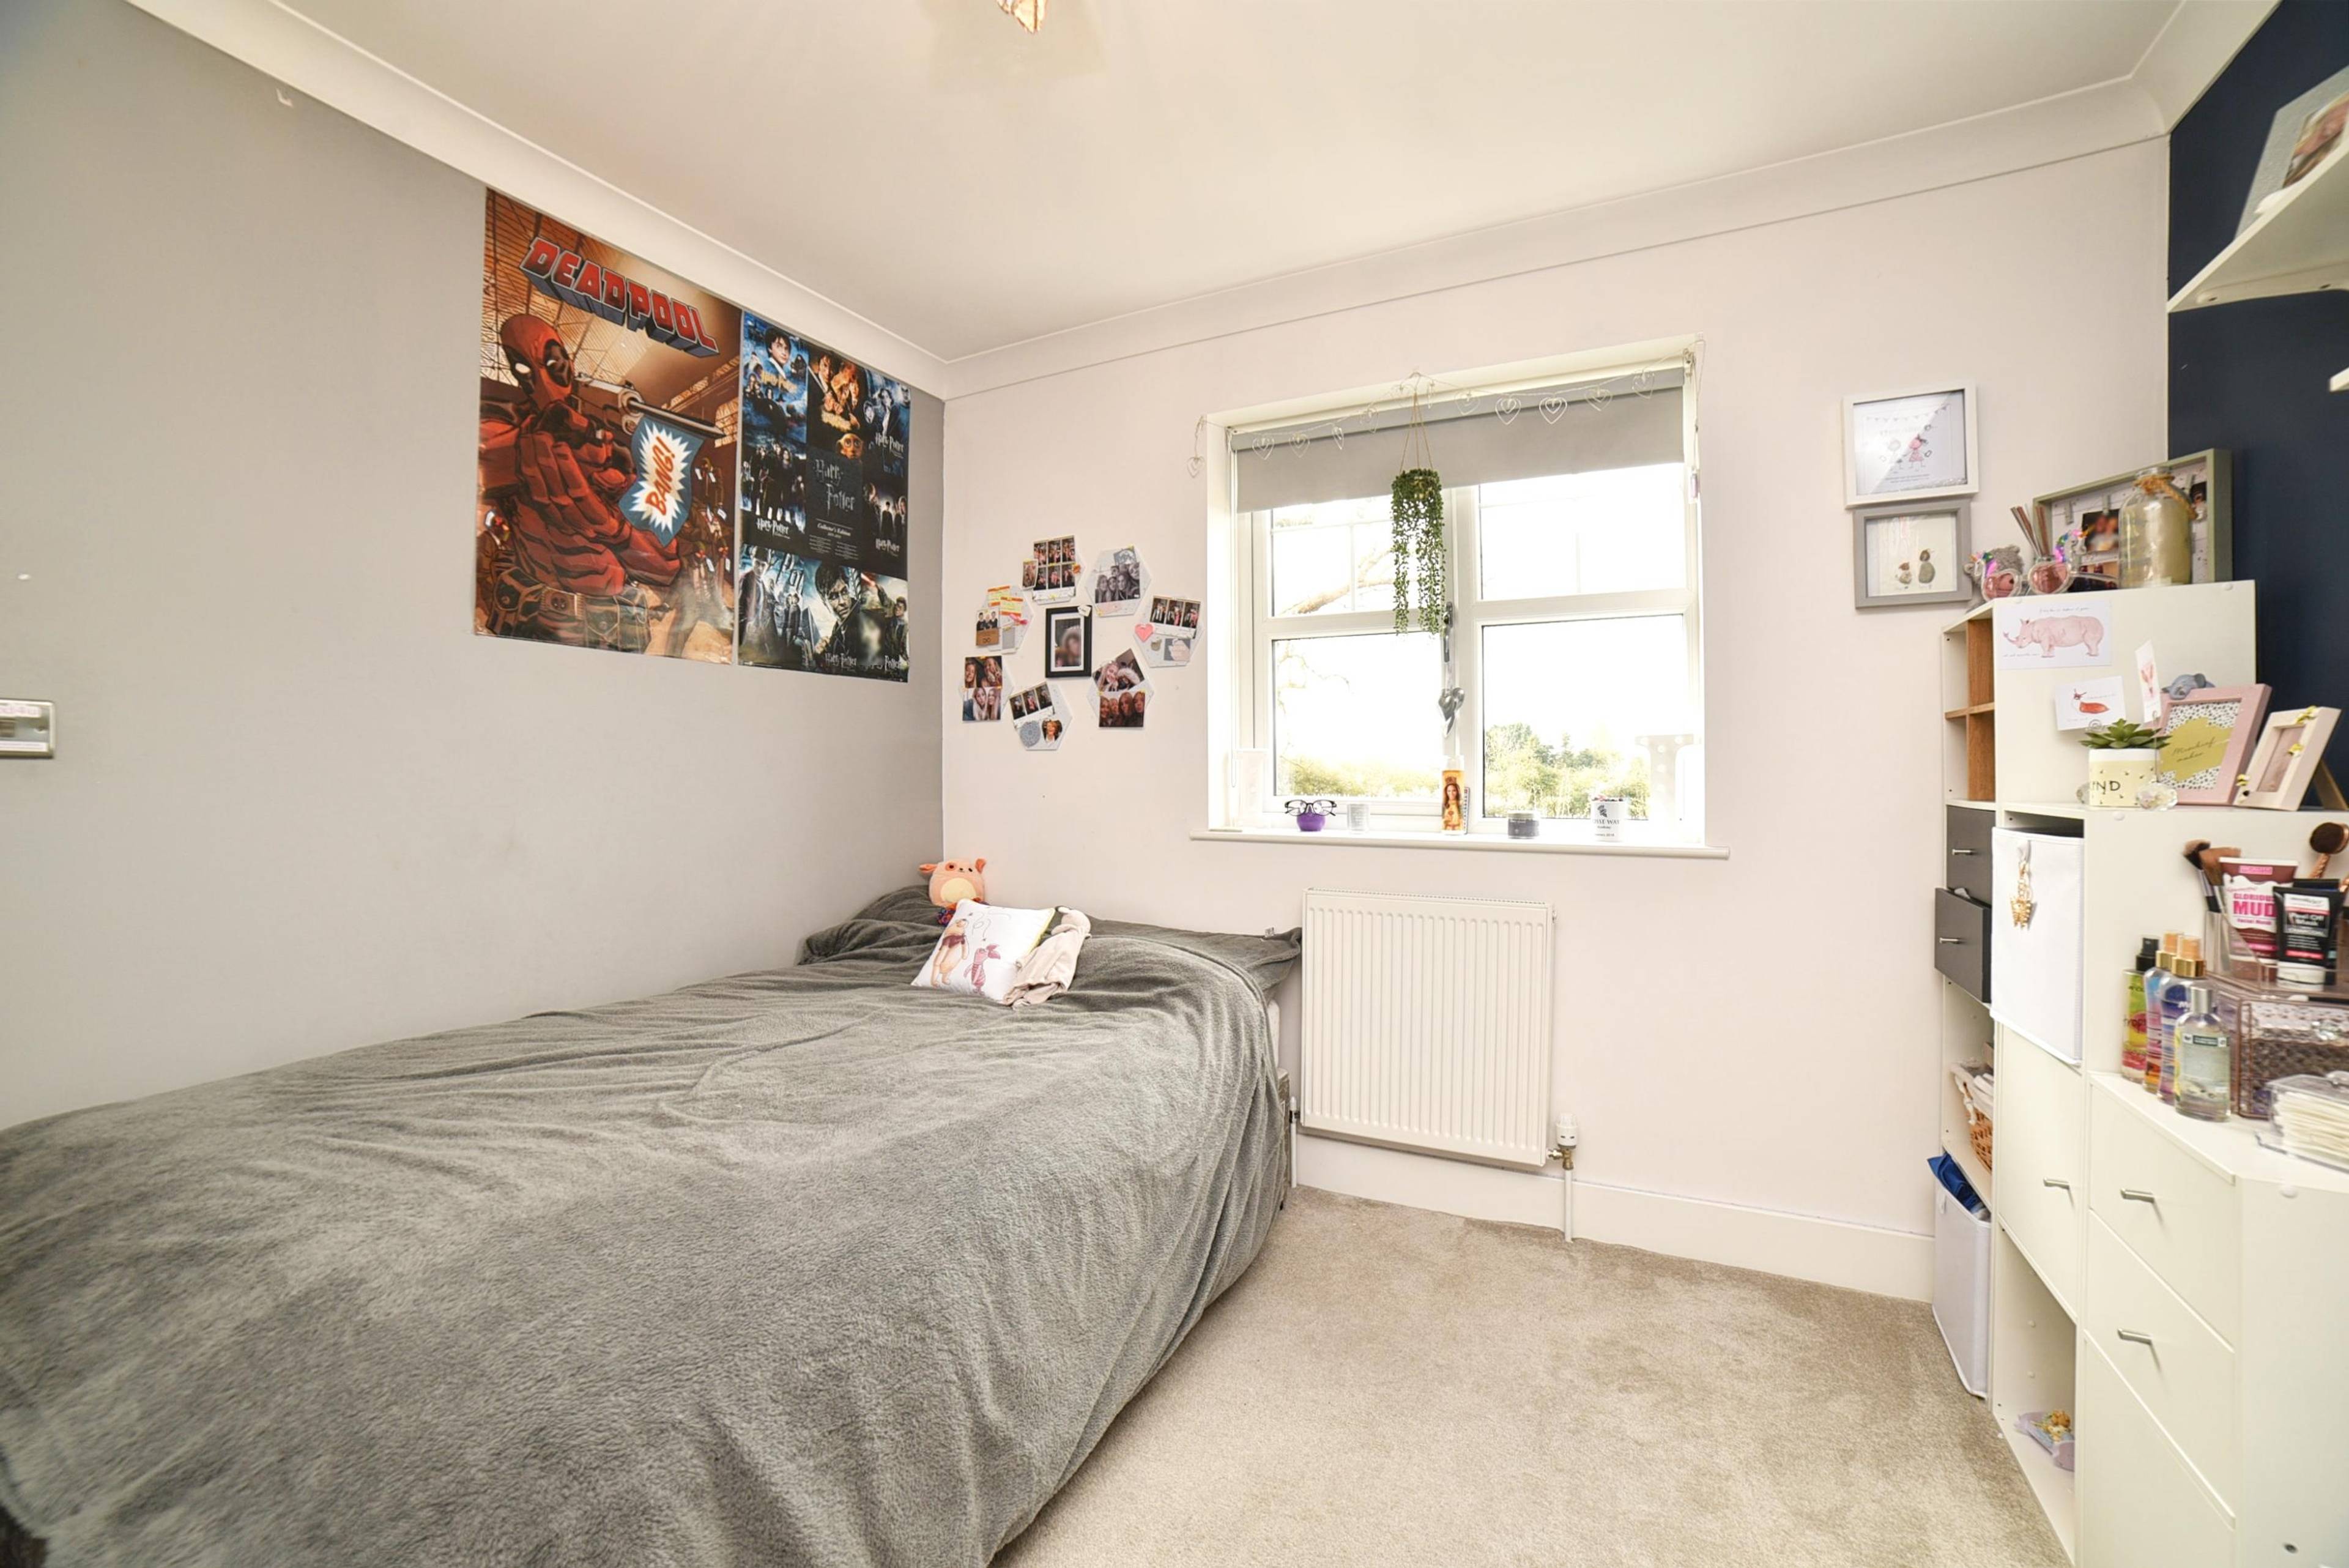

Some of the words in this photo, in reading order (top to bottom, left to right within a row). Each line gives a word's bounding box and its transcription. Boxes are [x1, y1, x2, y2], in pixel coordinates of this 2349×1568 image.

[519, 236, 719, 358] DEADPOOL
[645, 436, 675, 515] BANG!
[2233, 901, 2277, 917] MUD
